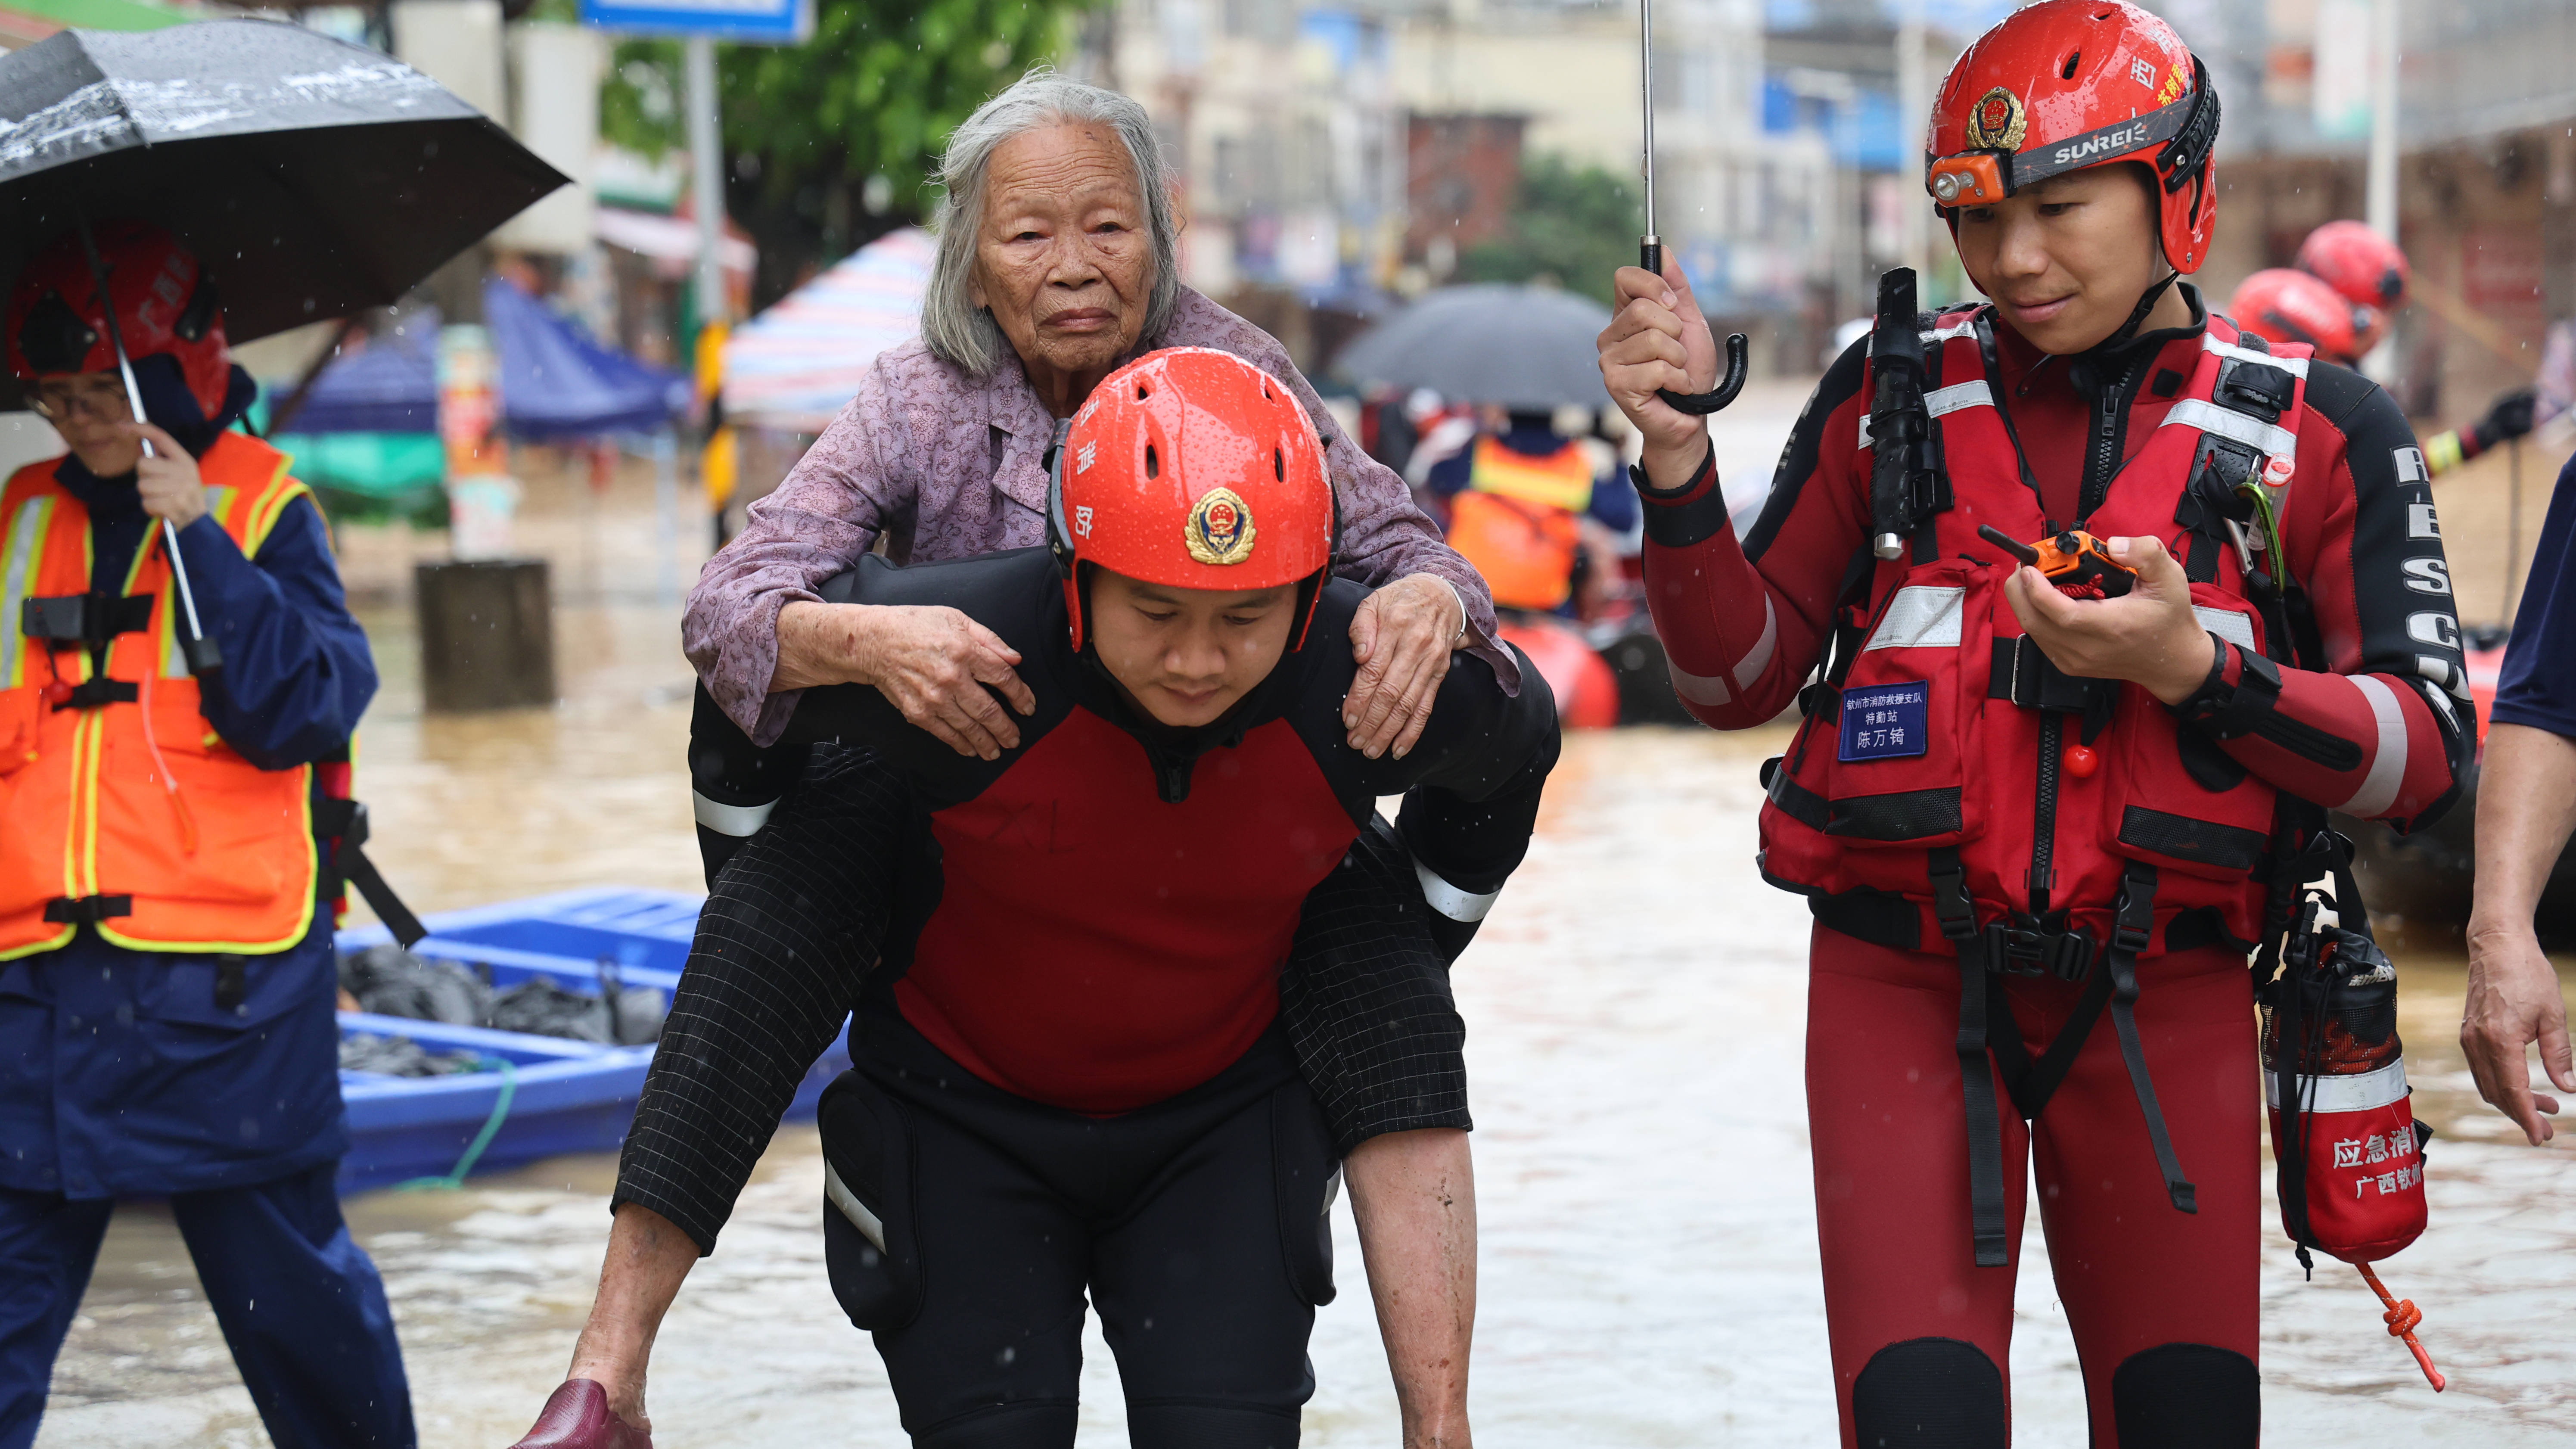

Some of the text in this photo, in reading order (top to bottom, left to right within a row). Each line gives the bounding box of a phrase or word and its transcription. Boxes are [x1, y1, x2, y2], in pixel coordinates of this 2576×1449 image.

[1846, 692, 1922, 711] 钦州市消防救援支队
[1865, 709, 1898, 725] 特勤站
[1857, 726, 1905, 749] 陈万锜
